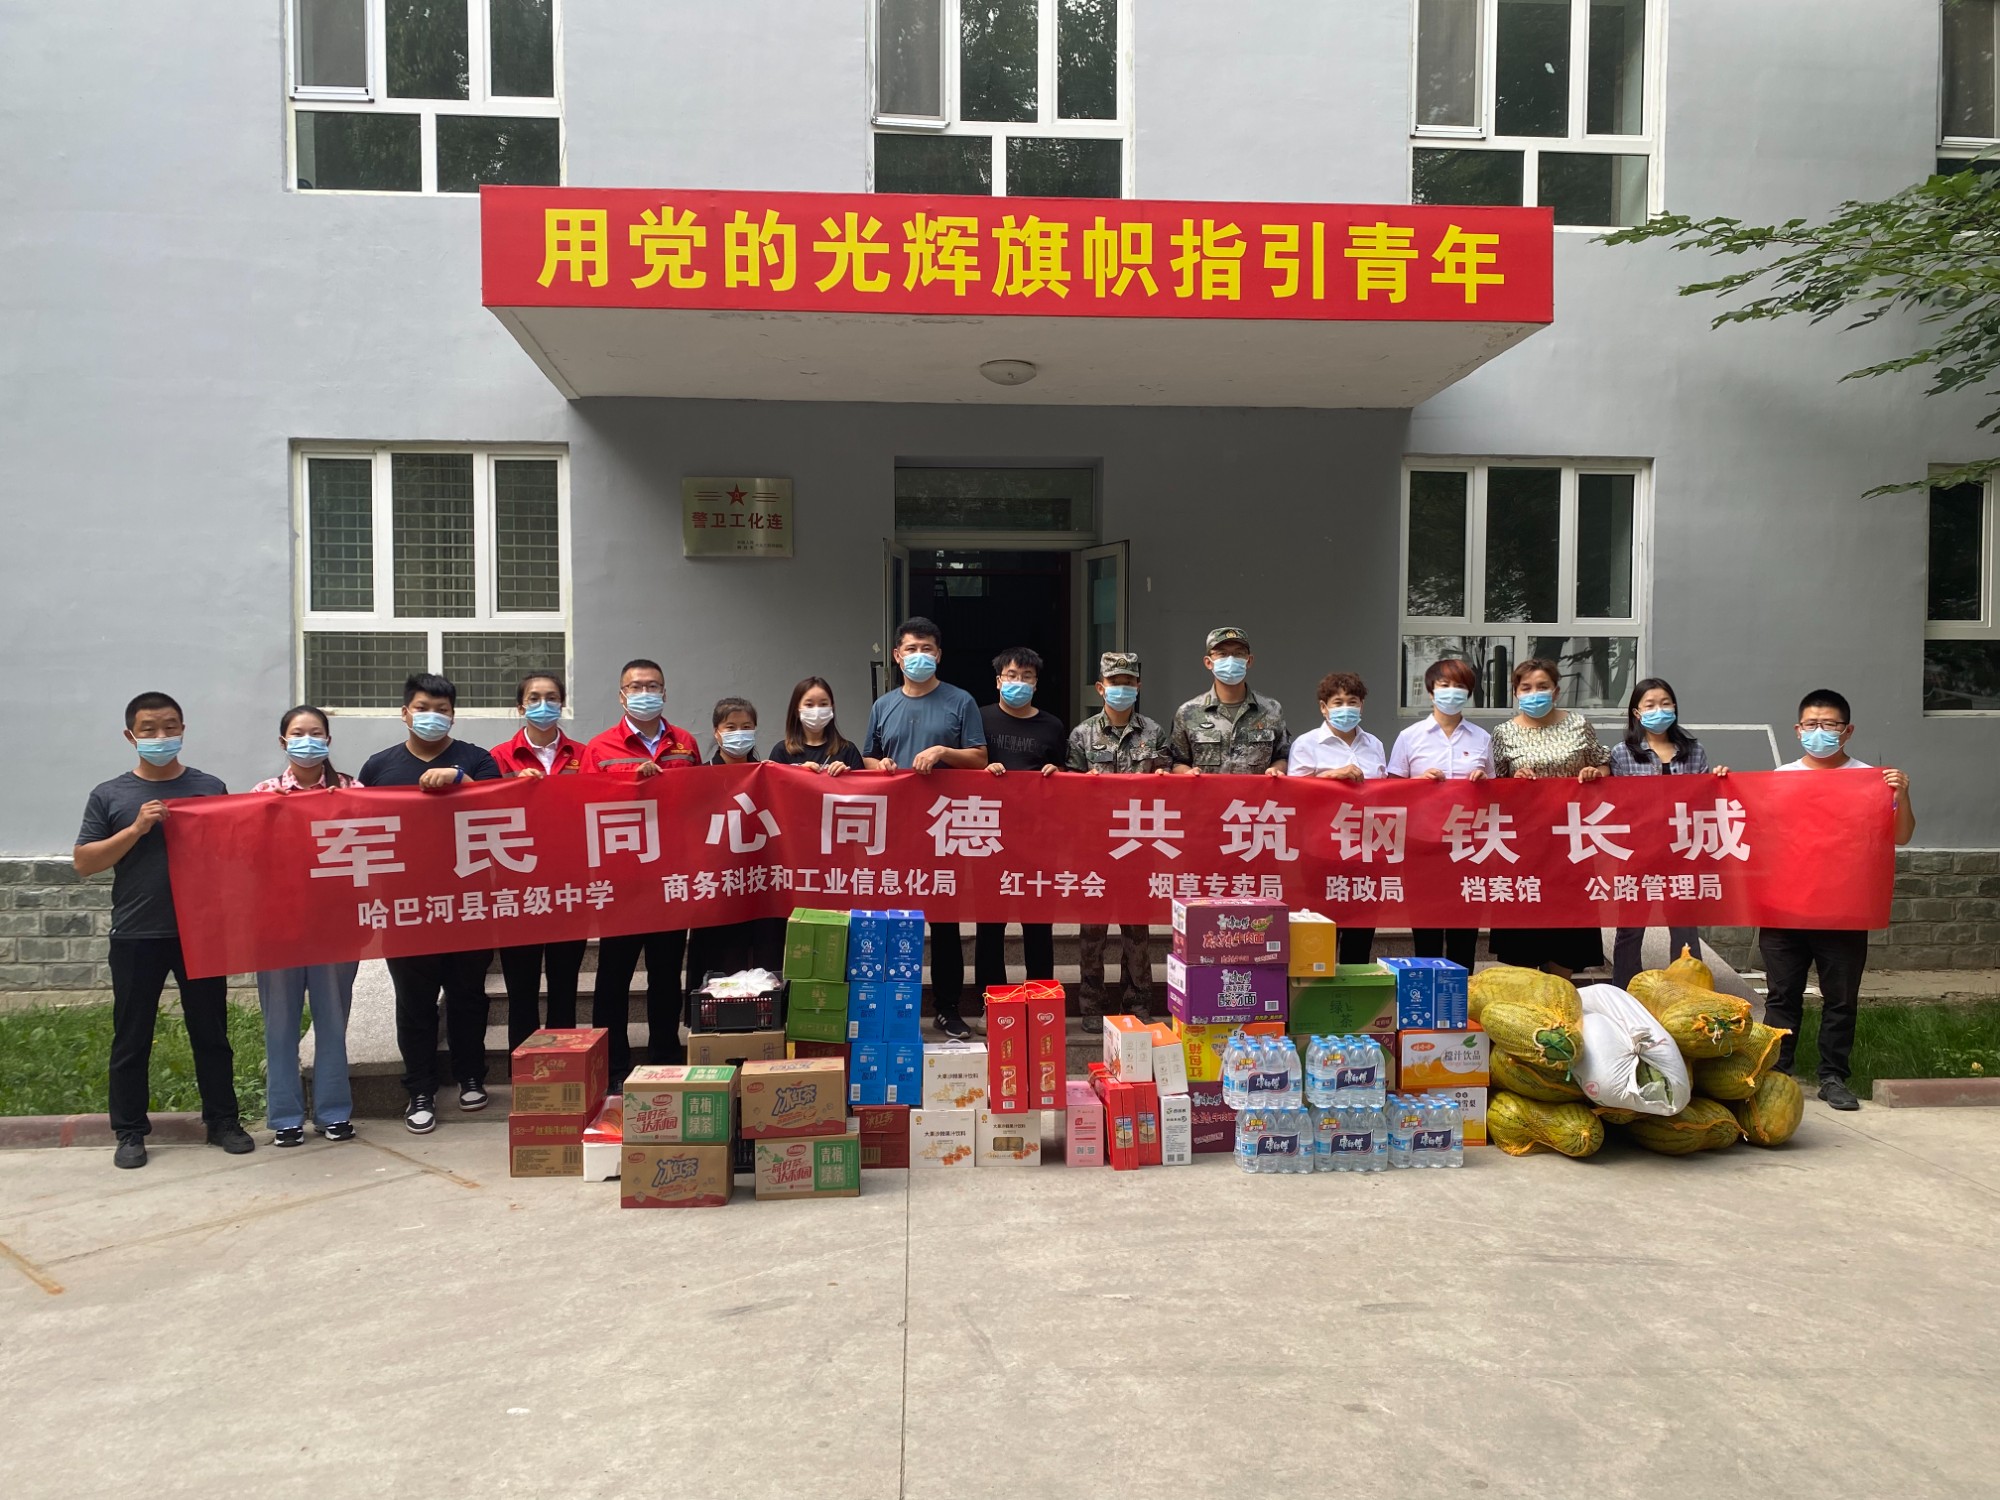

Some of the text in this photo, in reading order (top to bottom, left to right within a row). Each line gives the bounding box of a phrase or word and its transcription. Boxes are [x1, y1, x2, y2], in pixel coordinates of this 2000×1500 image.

[536, 206, 1505, 304] 用党的光辉旗帜指引青年
[692, 512, 783, 529] 警卫工化连
[310, 793, 1751, 887] 军民同心同德 共筑钢铁长城
[358, 864, 1722, 930] 哈巴河县高级中学 商务科技和工业信息化局 红十字会 烟草专卖局 路政局 档案馆 公路管理局
[1444, 1050, 1481, 1061] 橙汁饮品
[1256, 1074, 1280, 1089] 康师傅
[1344, 1069, 1368, 1084] 康师傅
[689, 1097, 712, 1114] 青梅
[771, 1084, 817, 1117] 冰红茶
[1265, 1137, 1289, 1152] 康师傅
[1339, 1135, 1364, 1150] 康师傅
[1421, 1132, 1444, 1147] 康师傅
[820, 1147, 843, 1163] 青梅
[651, 1157, 699, 1188] 冰红茶
